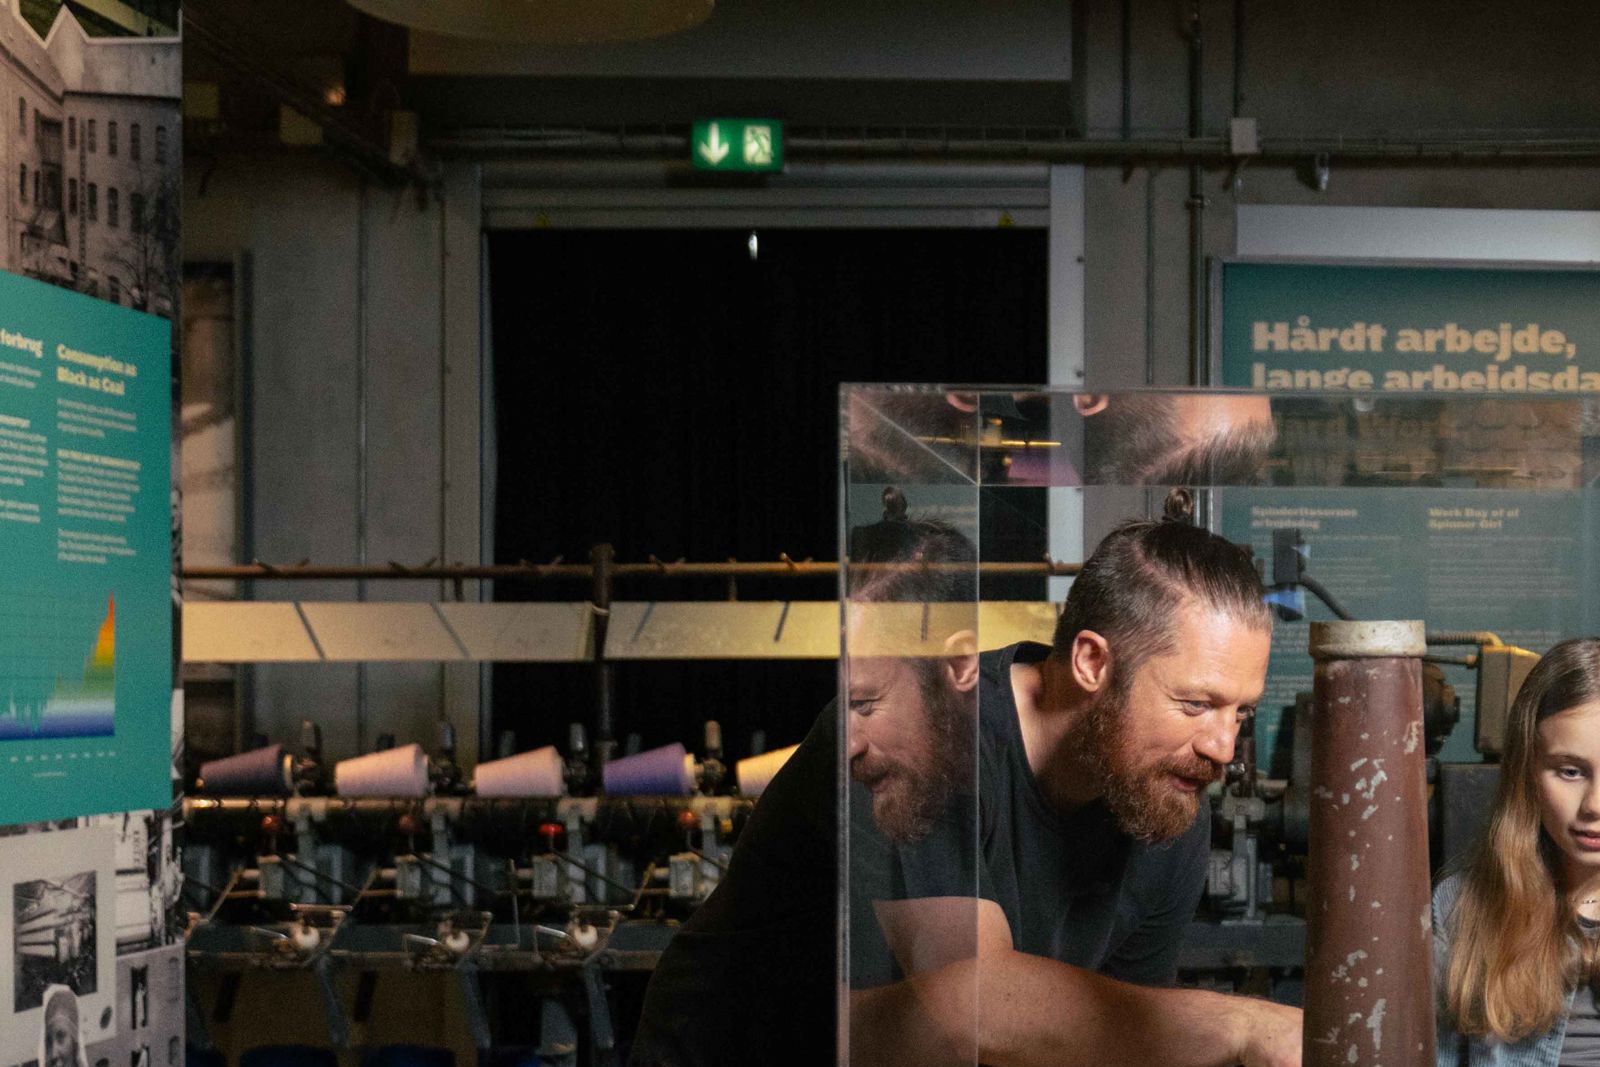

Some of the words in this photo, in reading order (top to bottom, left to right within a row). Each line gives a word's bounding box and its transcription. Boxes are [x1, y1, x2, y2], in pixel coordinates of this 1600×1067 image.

[1253, 315, 1387, 353] Hårdt
[1396, 322, 1576, 361] arbejde,
[1253, 362, 1374, 391] lange
